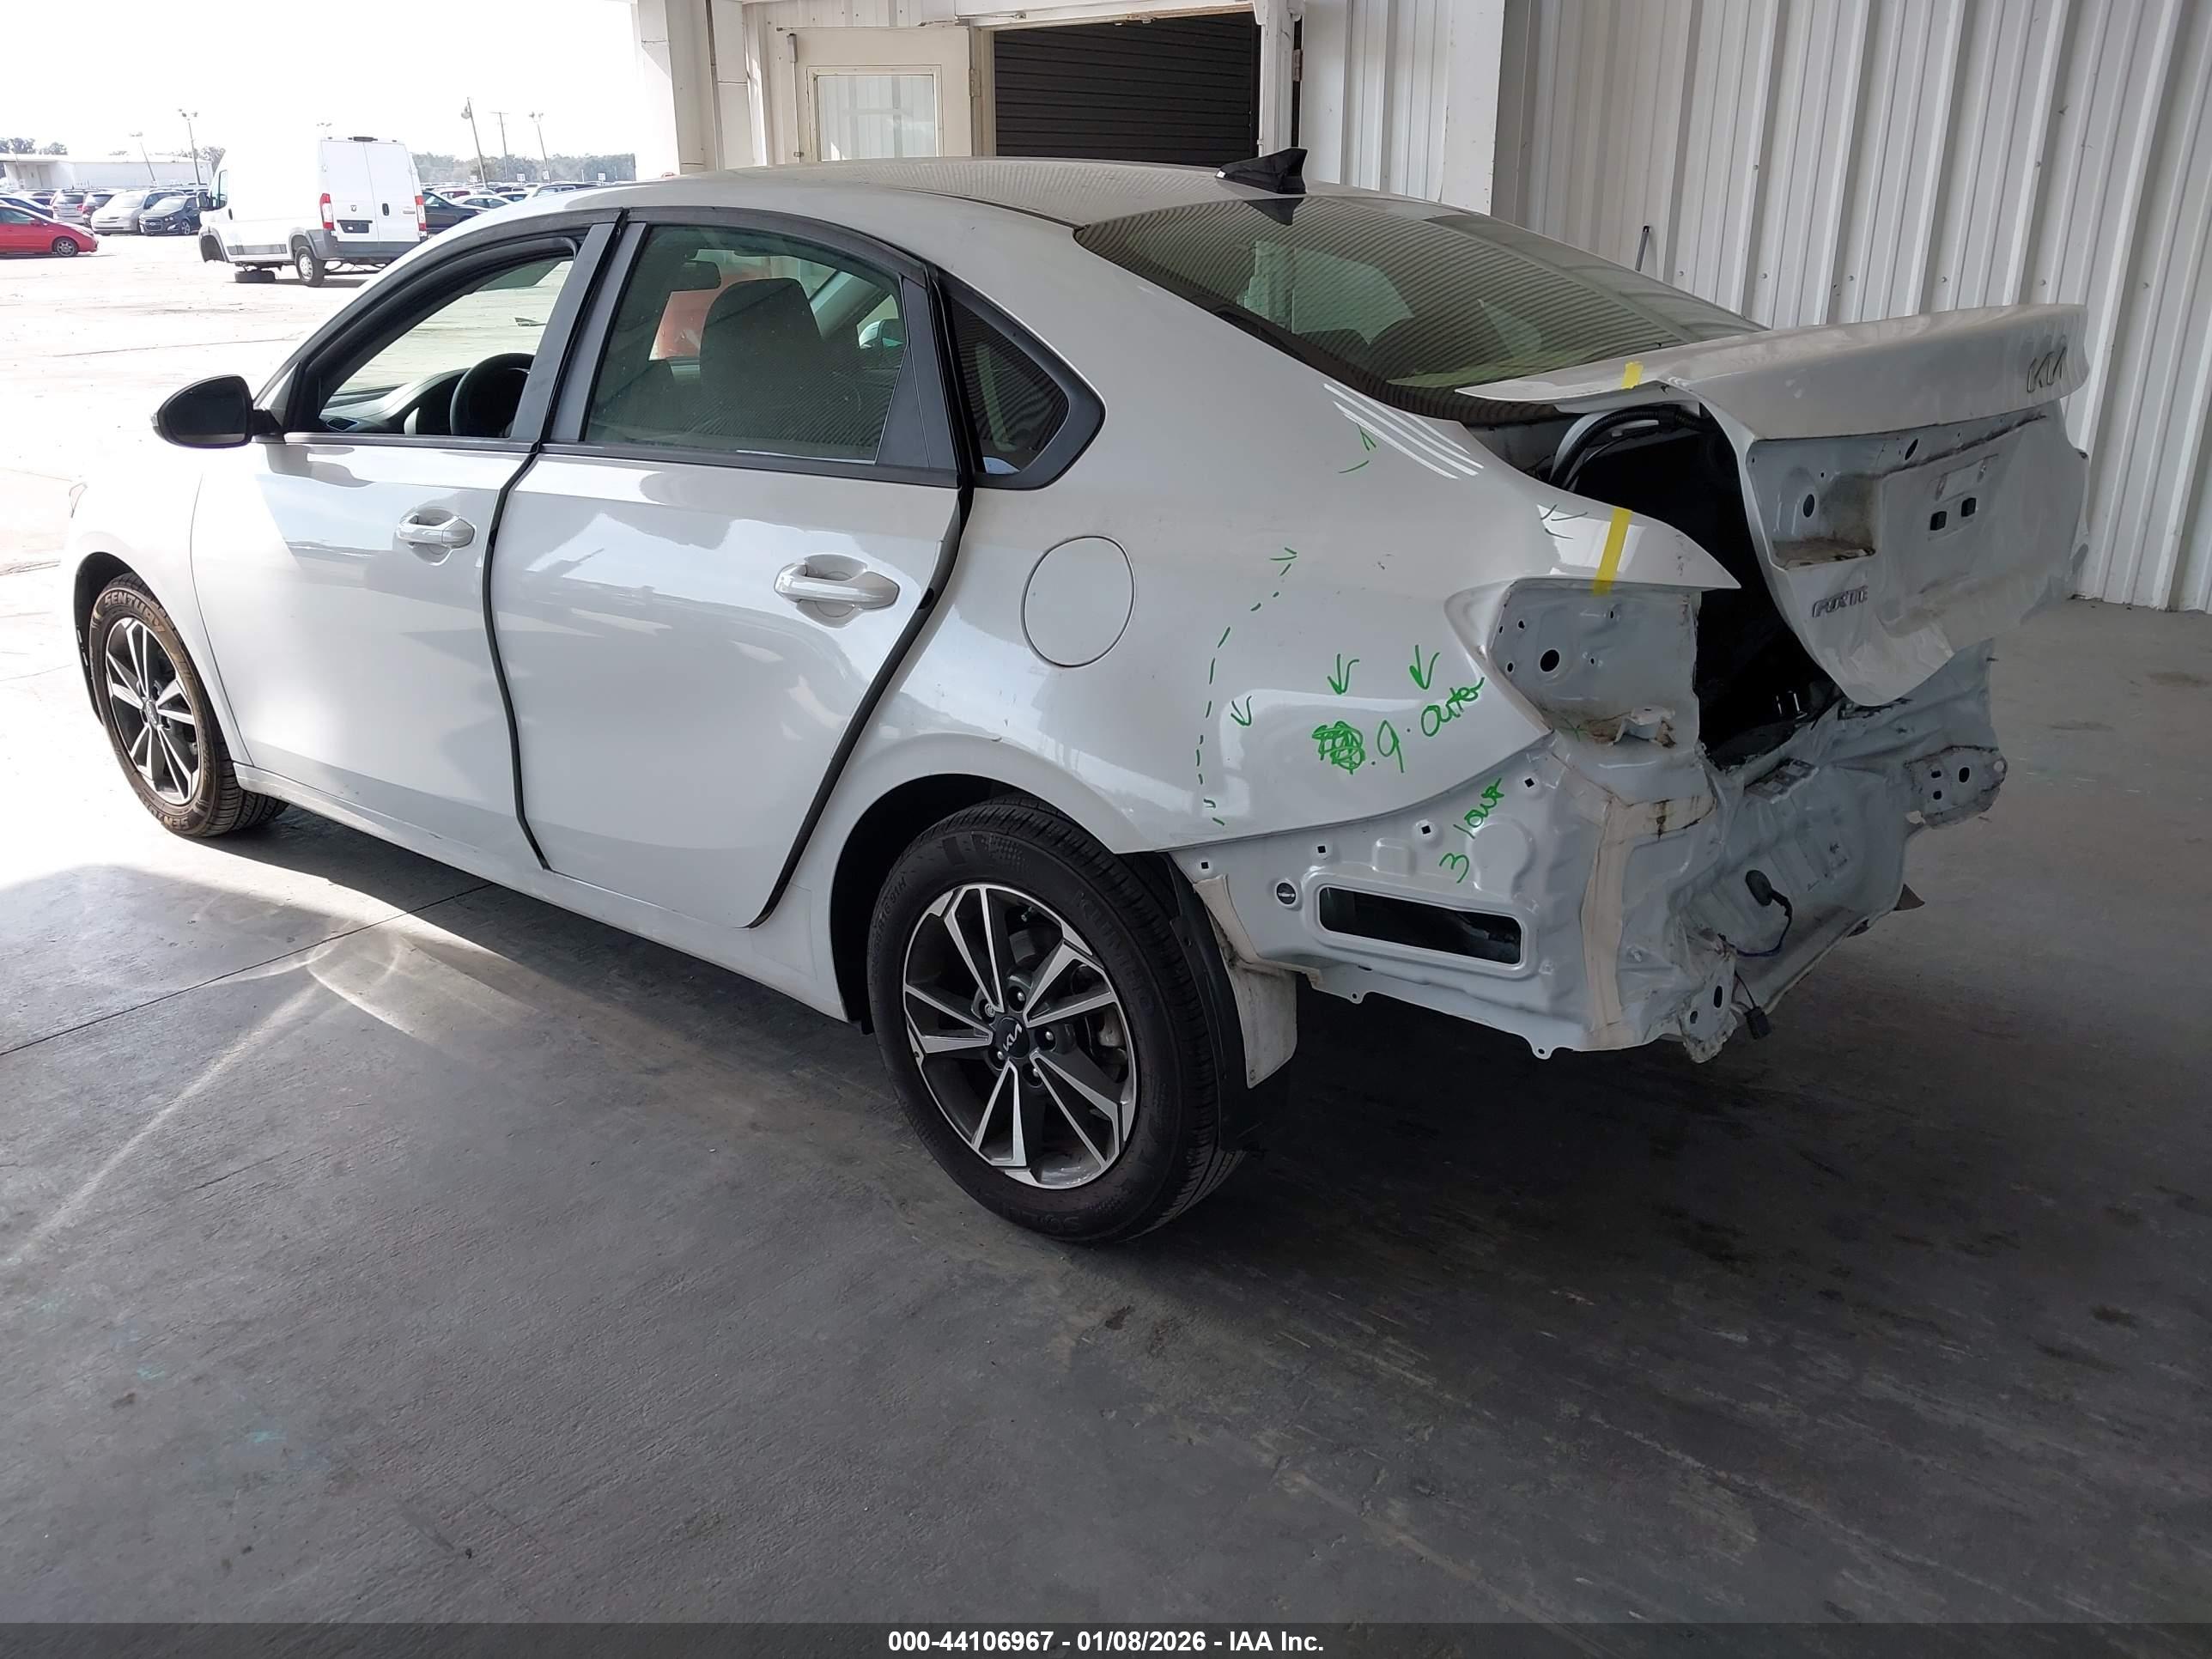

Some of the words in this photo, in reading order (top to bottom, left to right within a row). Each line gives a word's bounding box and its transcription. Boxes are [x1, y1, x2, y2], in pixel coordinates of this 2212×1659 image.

[2027, 346, 2067, 393] KIA
[104, 591, 167, 632] SENTURY
[1439, 852, 1470, 884] 3
[1002, 1023, 1023, 1052] KIA
